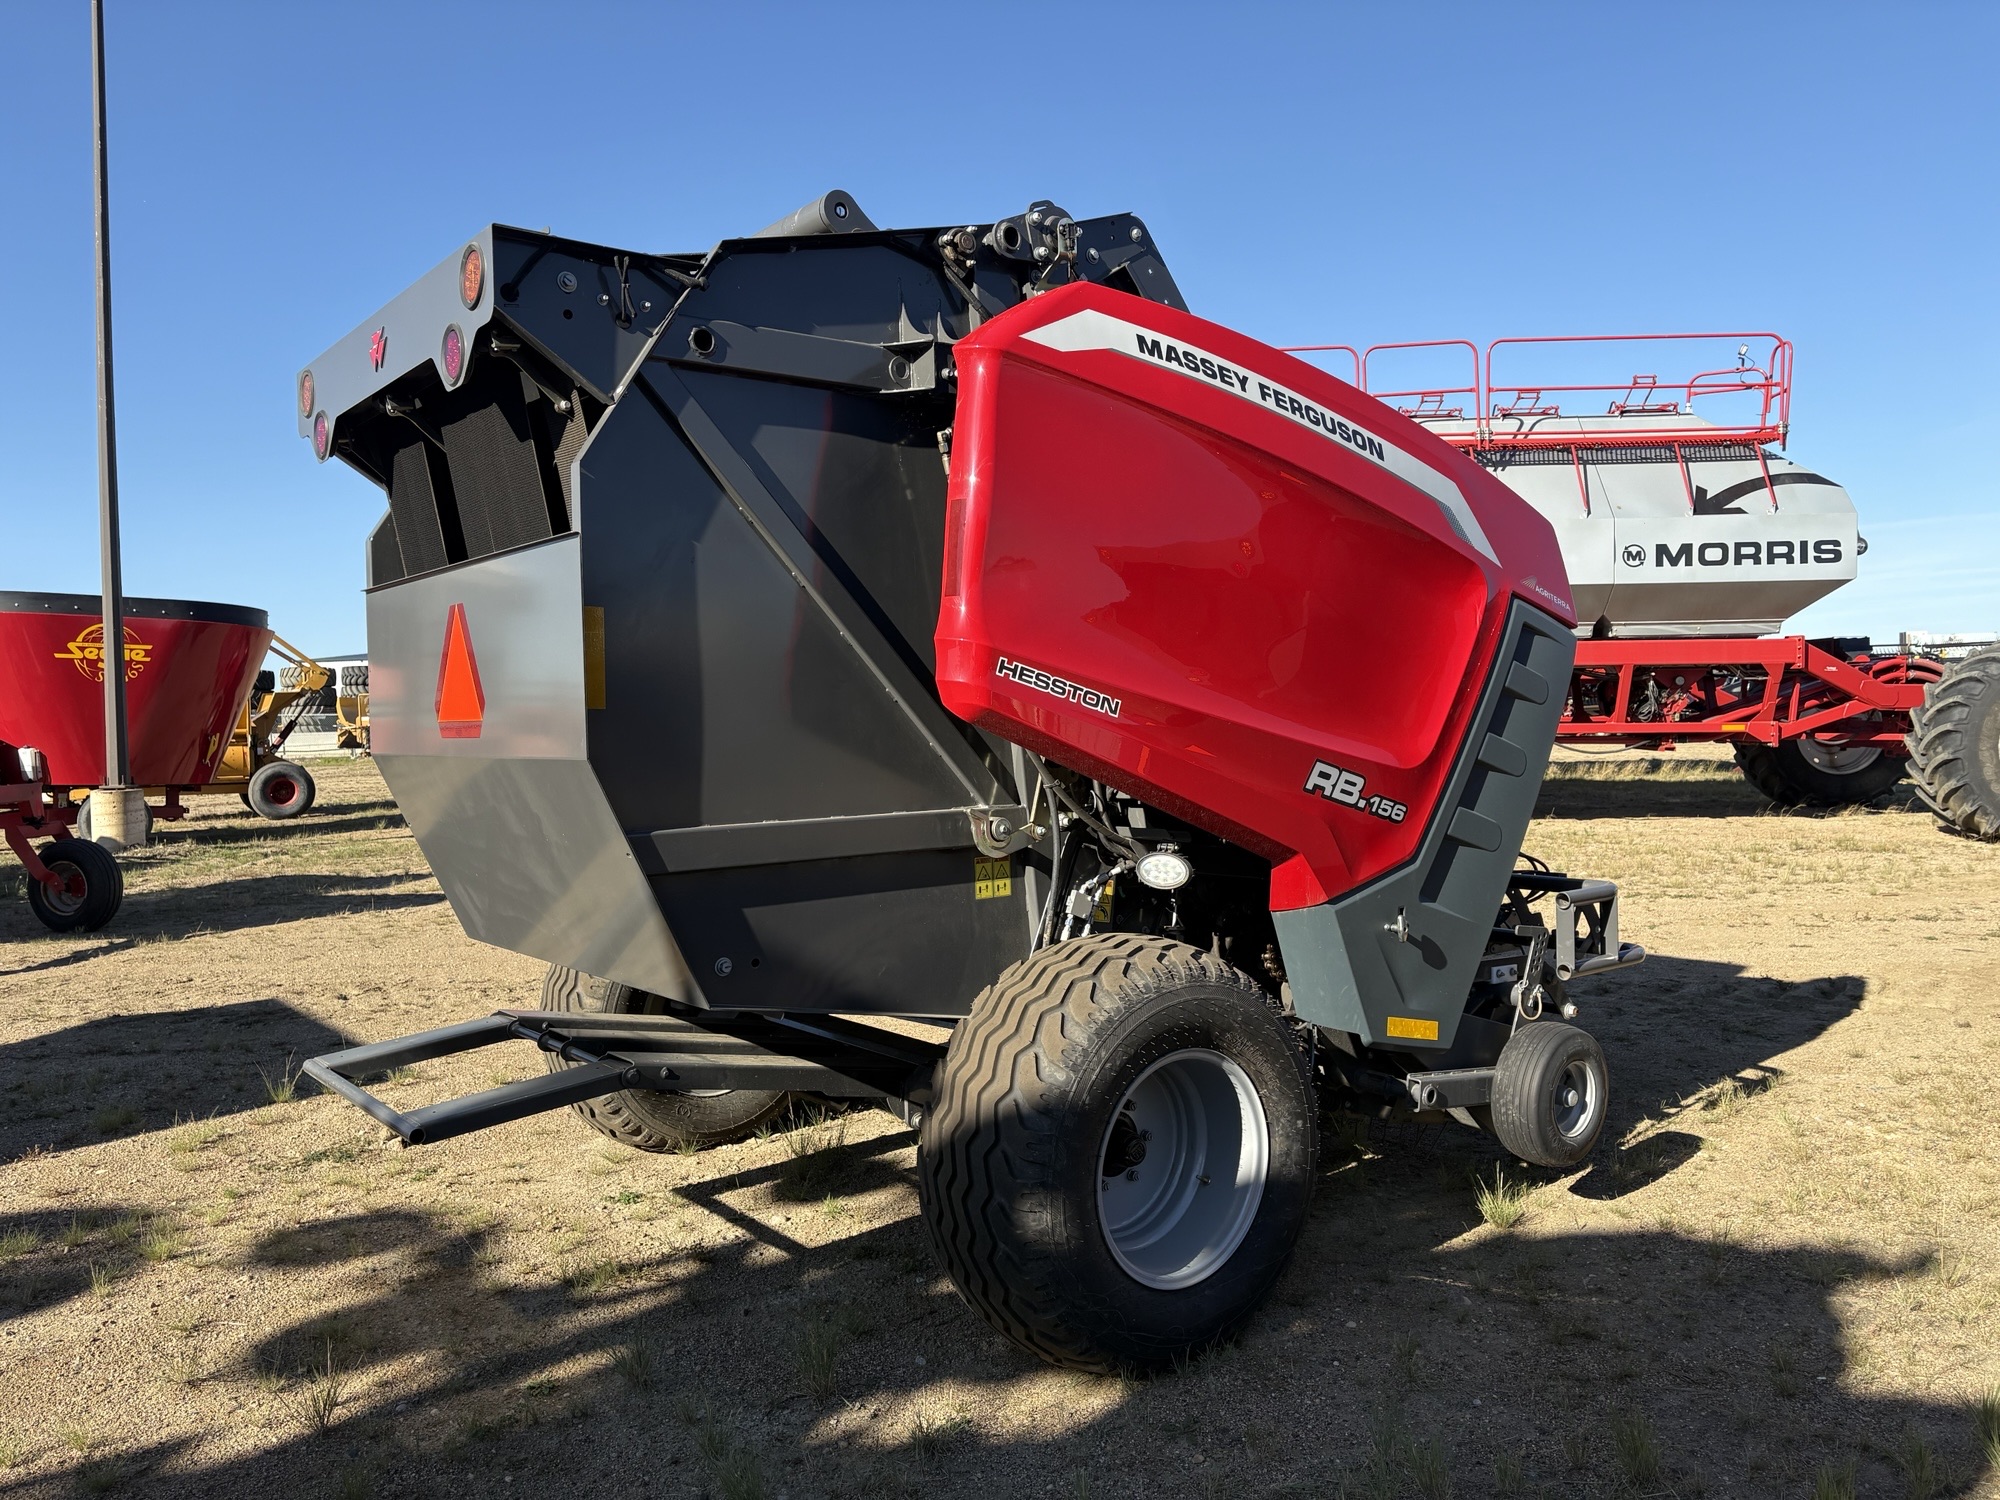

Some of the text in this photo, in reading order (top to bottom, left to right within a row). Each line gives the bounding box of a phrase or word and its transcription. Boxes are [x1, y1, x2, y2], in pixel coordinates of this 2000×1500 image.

[1136, 333, 1386, 462] MASSEY FERGUSON
[1655, 539, 1843, 567] MORRIS
[1535, 585, 1571, 611] AGRITERRA
[996, 656, 1122, 718] HESSTON
